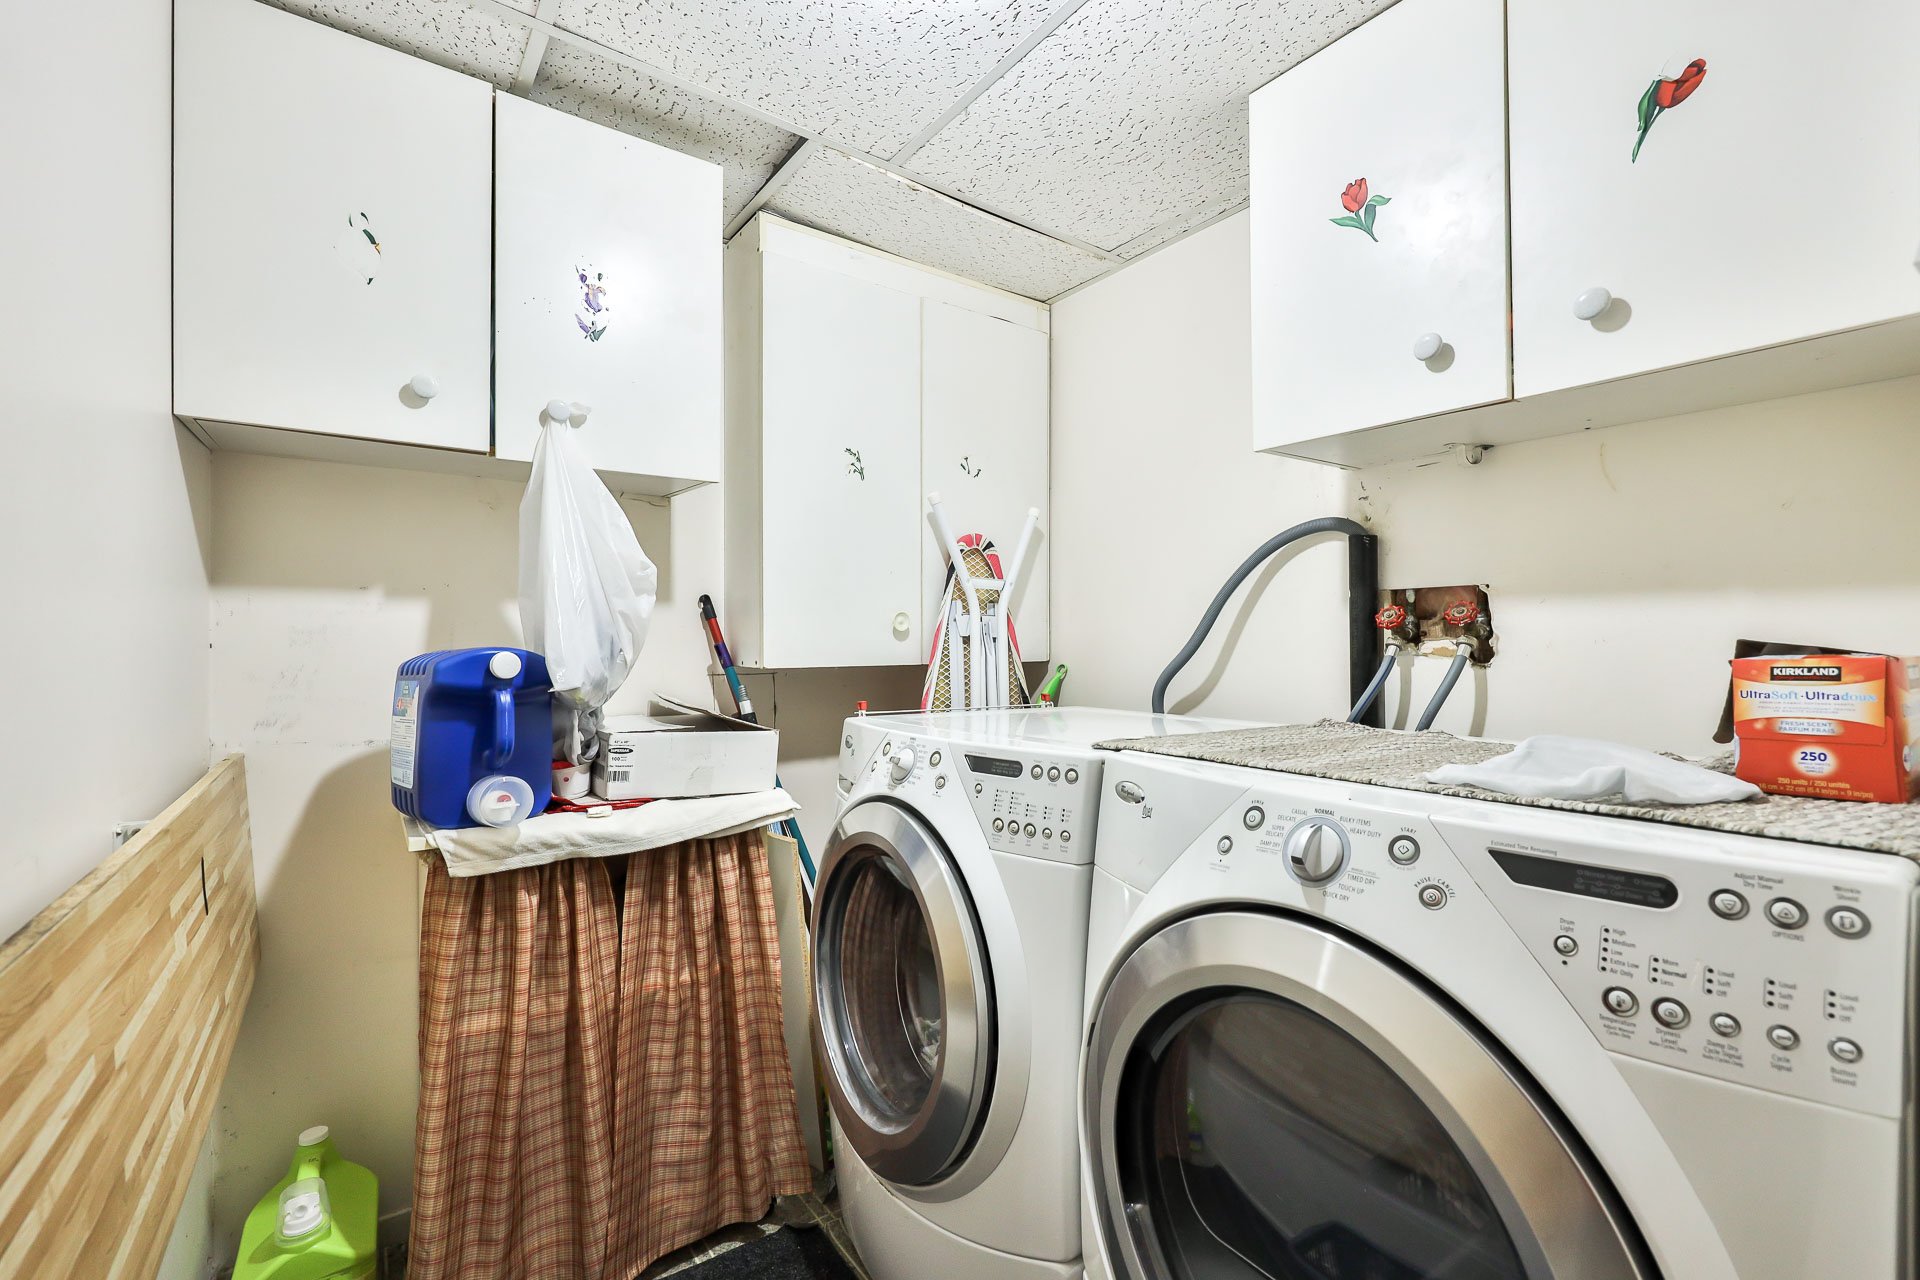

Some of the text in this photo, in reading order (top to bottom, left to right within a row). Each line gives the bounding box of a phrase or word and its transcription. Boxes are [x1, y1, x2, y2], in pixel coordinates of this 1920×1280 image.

[1773, 668, 1839, 676] KIRKLAND
[1740, 690, 1798, 700] UltraSoft
[1800, 751, 1827, 762] 250
[1291, 808, 1308, 816] CASUAL
[1314, 808, 1335, 816] NORMAL
[1349, 828, 1382, 838] HEAVY DUTY
[1400, 827, 1417, 835] START
[1347, 873, 1364, 883] TIMED
[1338, 883, 1356, 893] TOUCH
[1559, 917, 1575, 926] Drum
[1559, 924, 1575, 933] Light
[1611, 938, 1636, 948] Medium
[1661, 968, 1687, 979] Normal
[1599, 1013, 1637, 1028] Temperature
